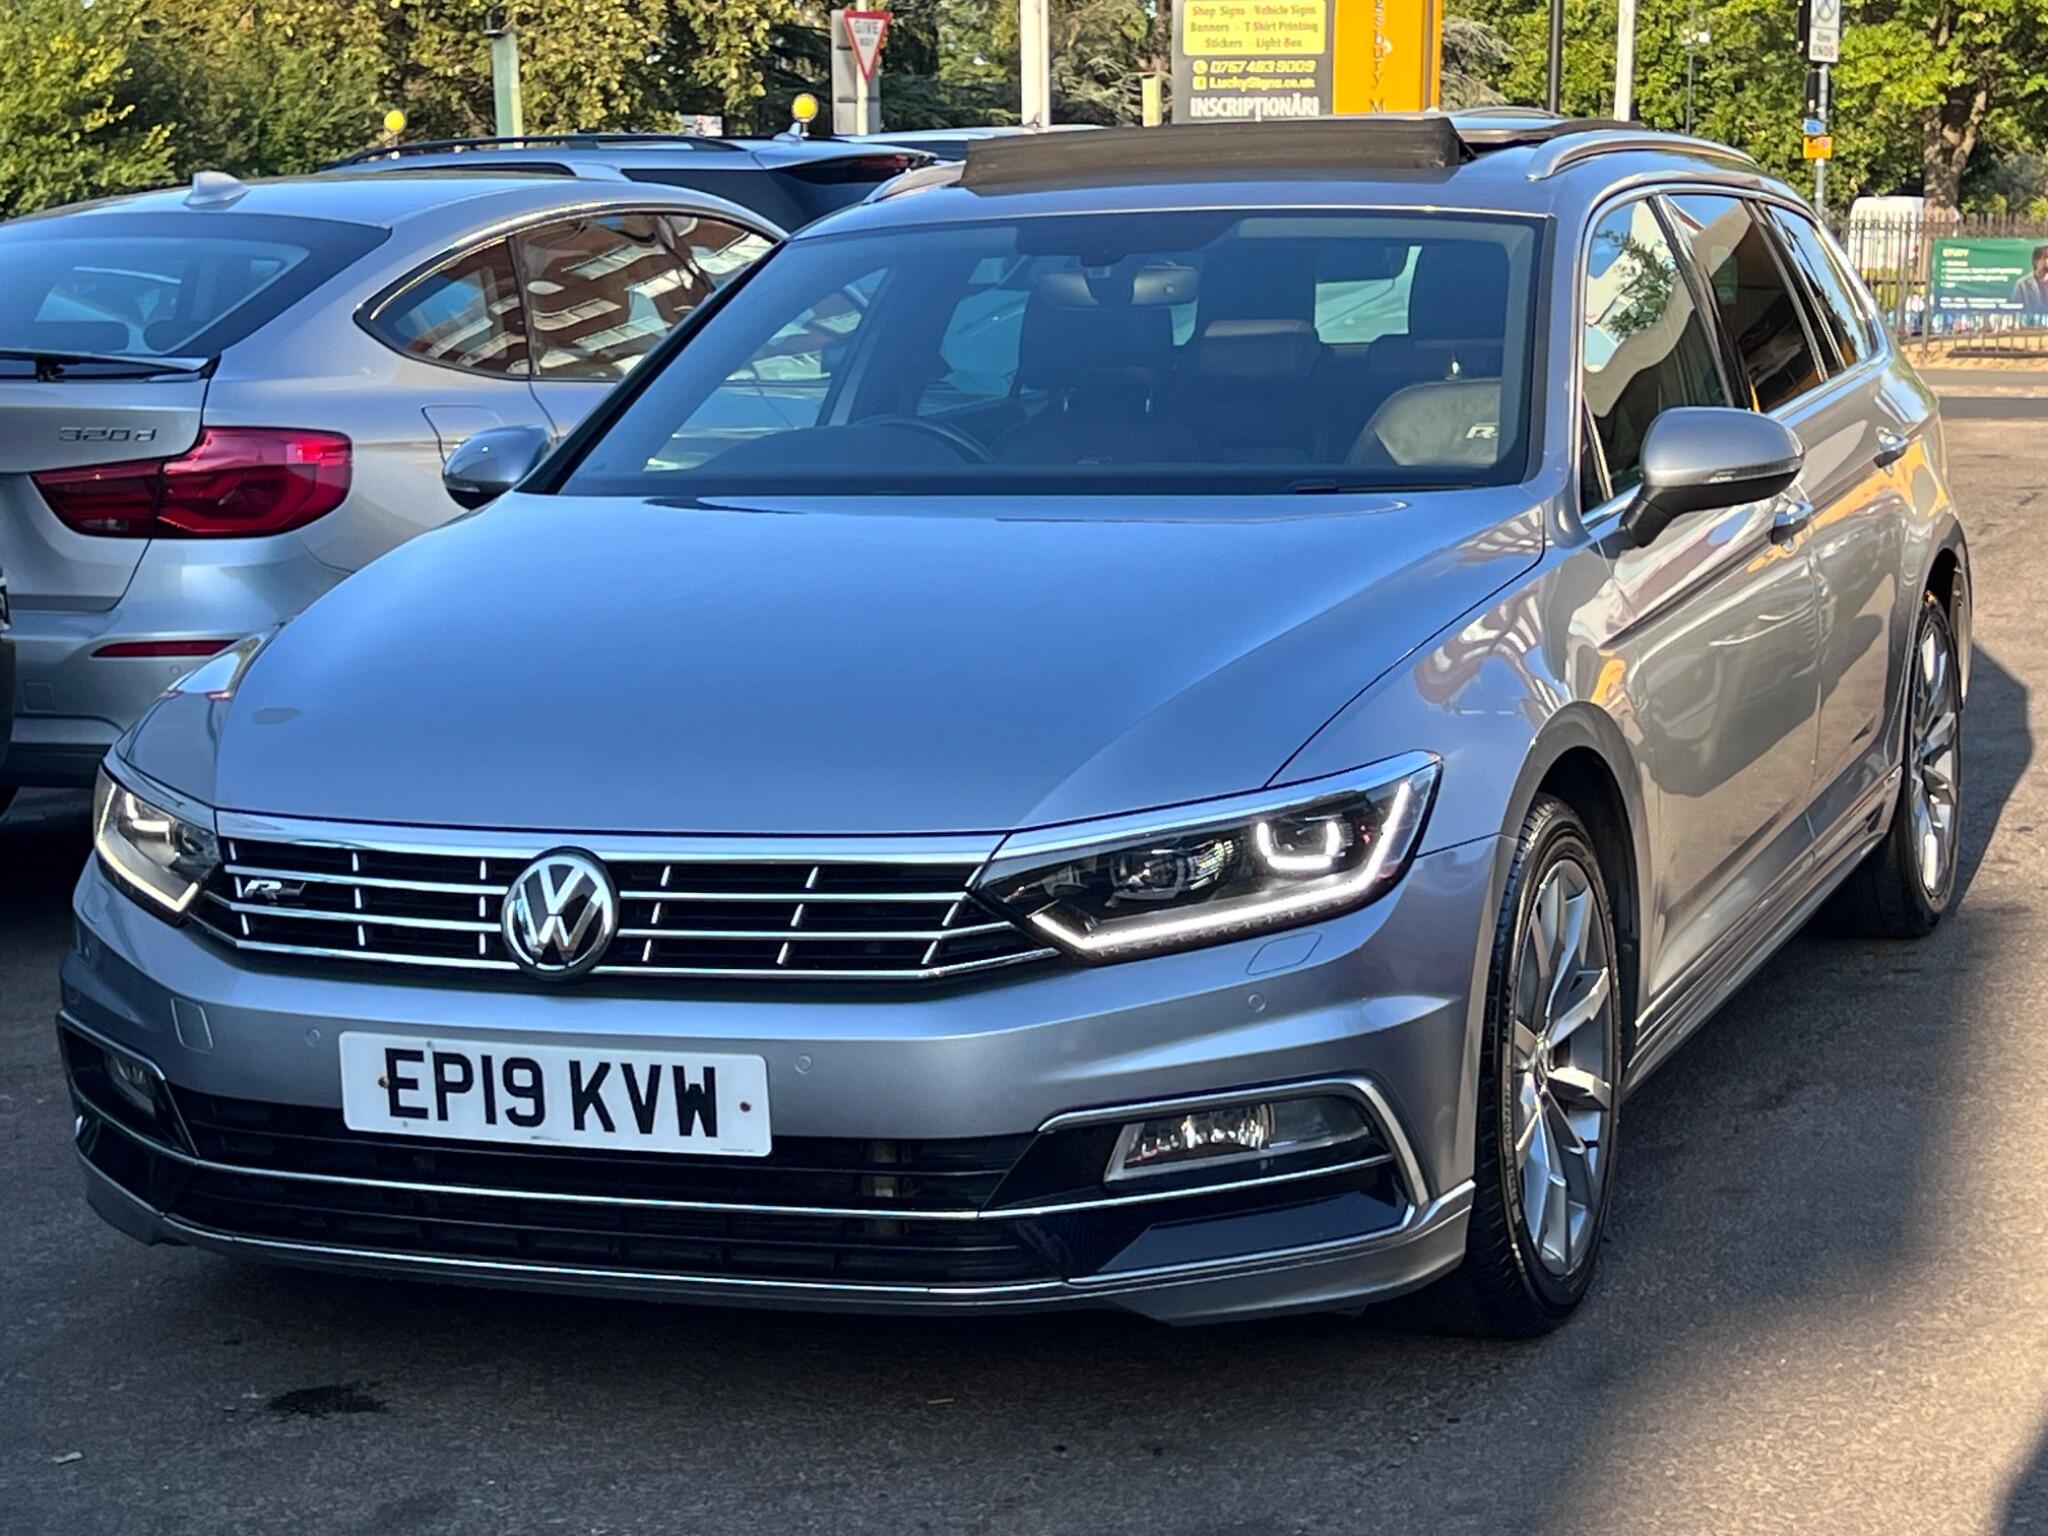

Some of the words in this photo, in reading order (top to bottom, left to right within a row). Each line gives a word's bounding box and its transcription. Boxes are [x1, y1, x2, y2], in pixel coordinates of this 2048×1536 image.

[1193, 6, 1216, 18] Shop
[1220, 6, 1246, 19] Signs
[1254, 5, 1289, 15] Vehicle
[1291, 5, 1317, 17] Signs
[1190, 22, 1230, 32] Banners
[1252, 21, 1277, 31] Shirt
[1278, 21, 1318, 33] Printing
[1205, 38, 1243, 48] Stickers
[1256, 38, 1281, 50] Light
[1283, 37, 1303, 48] Box
[1210, 60, 1248, 73] 0757
[384, 1048, 545, 1128] EP19
[568, 1059, 719, 1138] KVW
